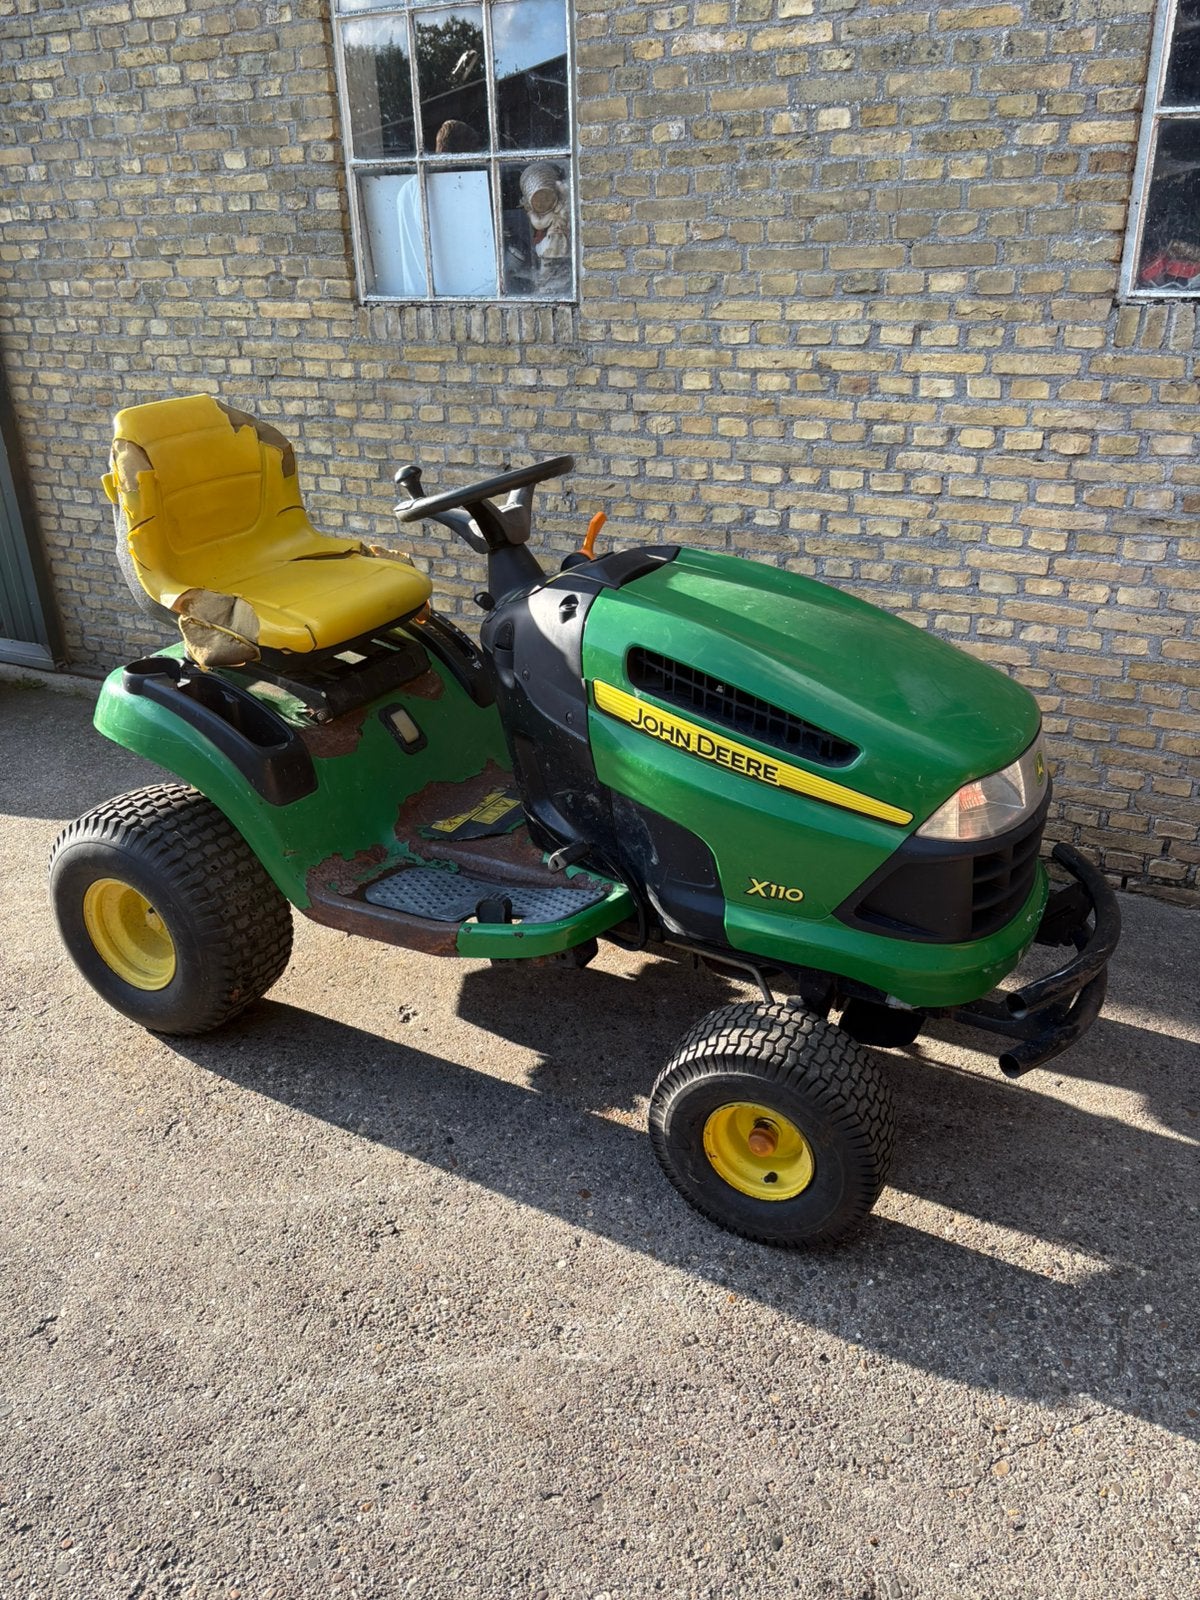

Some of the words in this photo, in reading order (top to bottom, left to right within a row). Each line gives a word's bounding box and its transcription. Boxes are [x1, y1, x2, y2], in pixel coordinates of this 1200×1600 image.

[630, 707, 692, 749] JOHN
[696, 733, 779, 783] DEERE
[745, 877, 804, 902] X110
